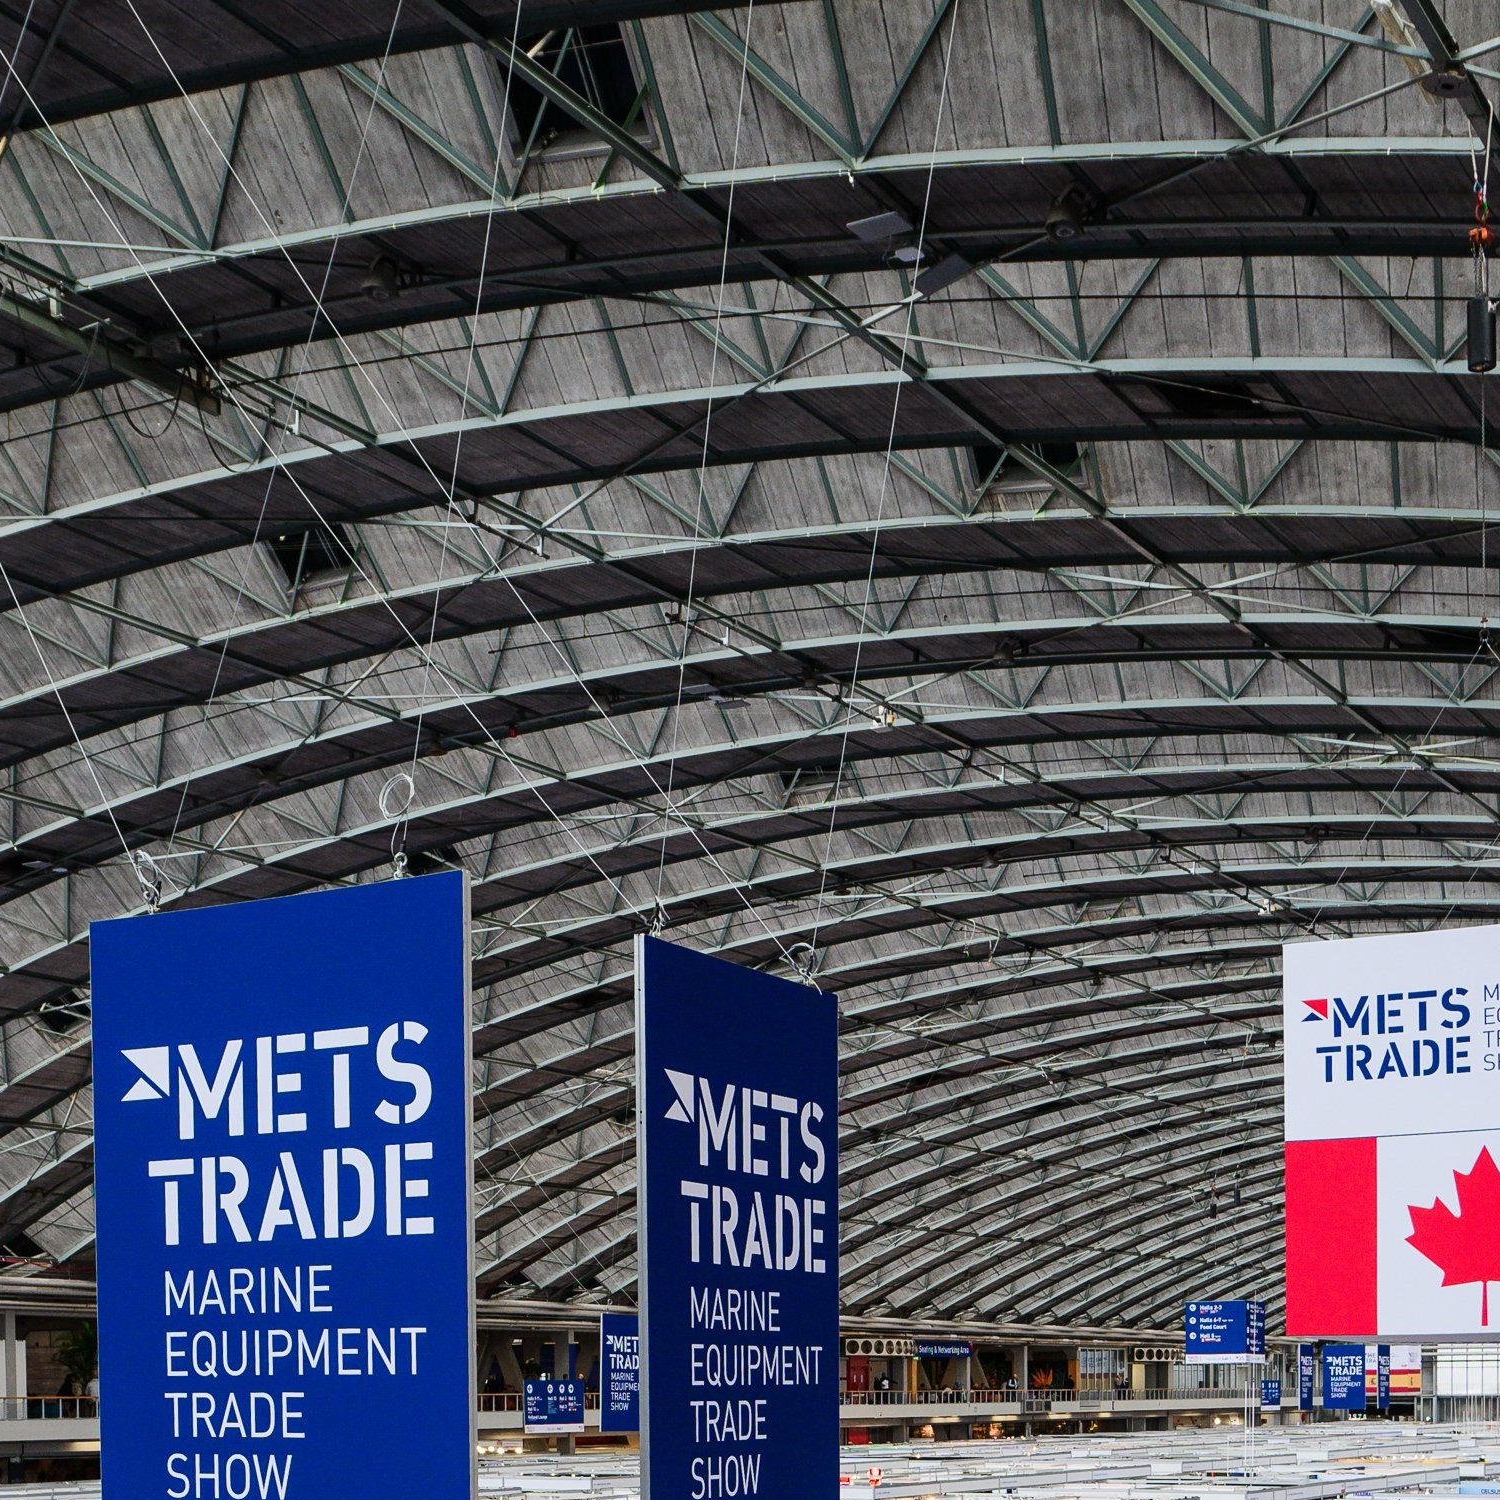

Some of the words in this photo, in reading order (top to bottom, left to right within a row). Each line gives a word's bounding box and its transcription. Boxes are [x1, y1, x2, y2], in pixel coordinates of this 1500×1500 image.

[1333, 986, 1470, 1038] METS
[178, 1021, 432, 1139] METS
[1316, 1036, 1471, 1082] TRADE
[699, 1077, 825, 1183] METS
[149, 1142, 434, 1245] TRADE
[681, 1181, 826, 1273] TRADE
[164, 1265, 332, 1316] MARINE
[690, 1286, 780, 1332] MARINE
[166, 1327, 427, 1377] EQUIPMENT
[691, 1344, 822, 1387] EQUIPMENT
[1329, 1367, 1362, 1375] TRADE
[1332, 1356, 1362, 1366] METS
[164, 1392, 305, 1438] TRADE
[690, 1400, 767, 1442] TRADE
[167, 1453, 293, 1500] SHOW
[692, 1454, 760, 1500] SHOW
